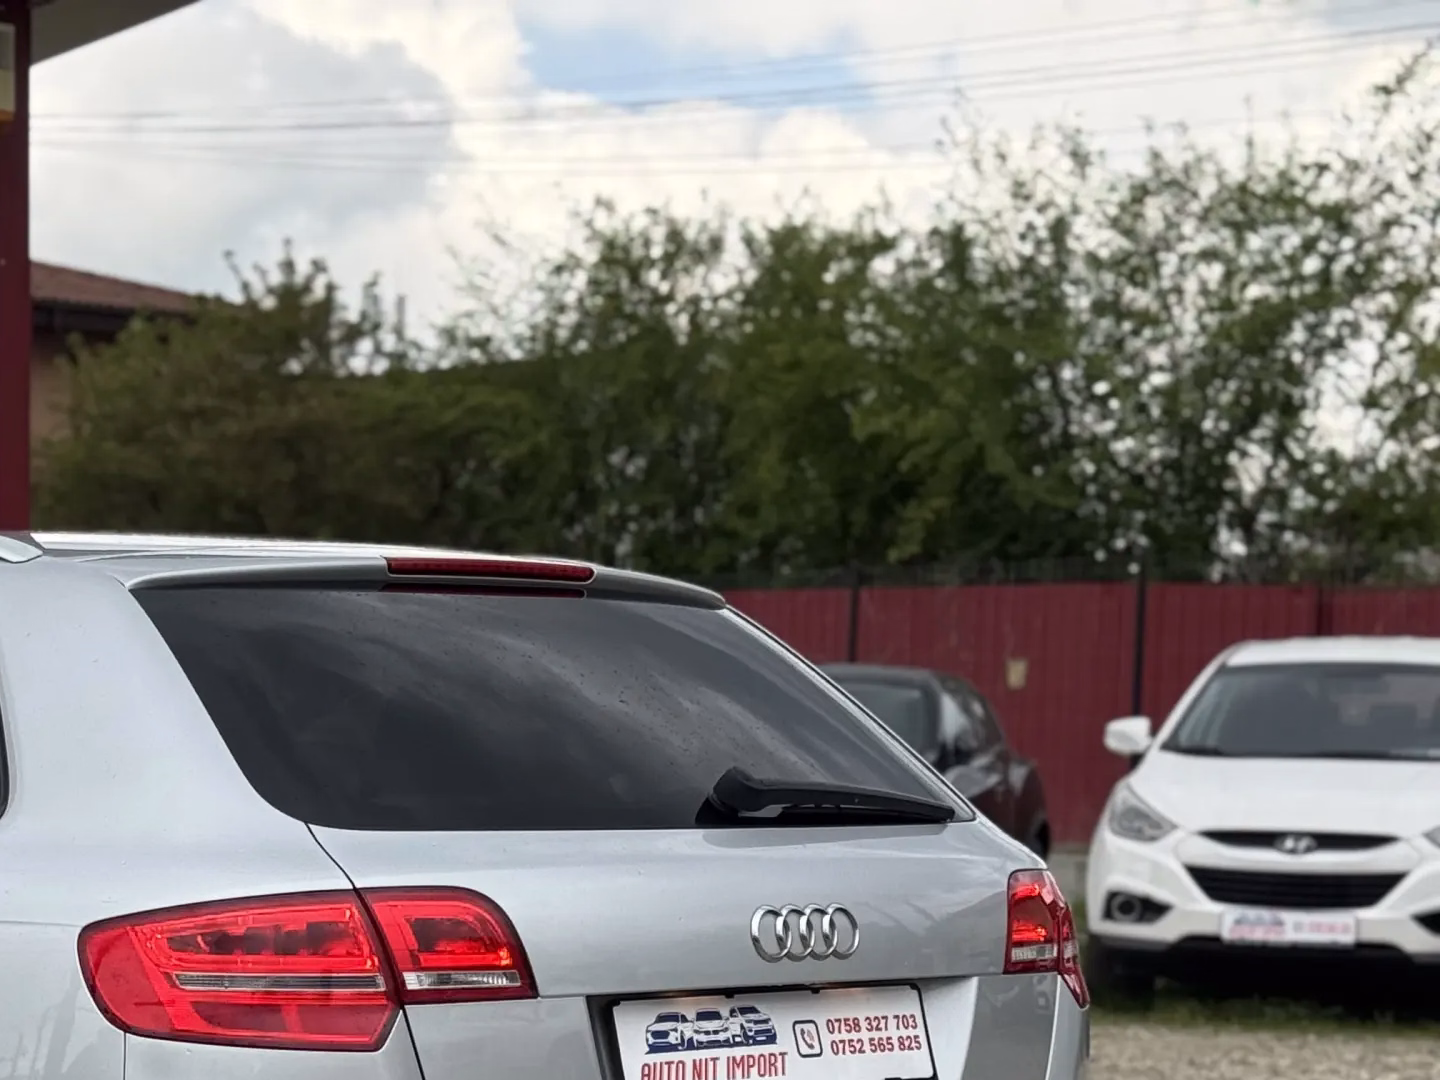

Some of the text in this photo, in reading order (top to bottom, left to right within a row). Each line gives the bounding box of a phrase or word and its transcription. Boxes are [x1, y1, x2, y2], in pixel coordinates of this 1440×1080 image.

[826, 1014, 918, 1035] 0758 327 703
[830, 1035, 922, 1056] 0752 565 825
[726, 1052, 788, 1080] IMPORT
